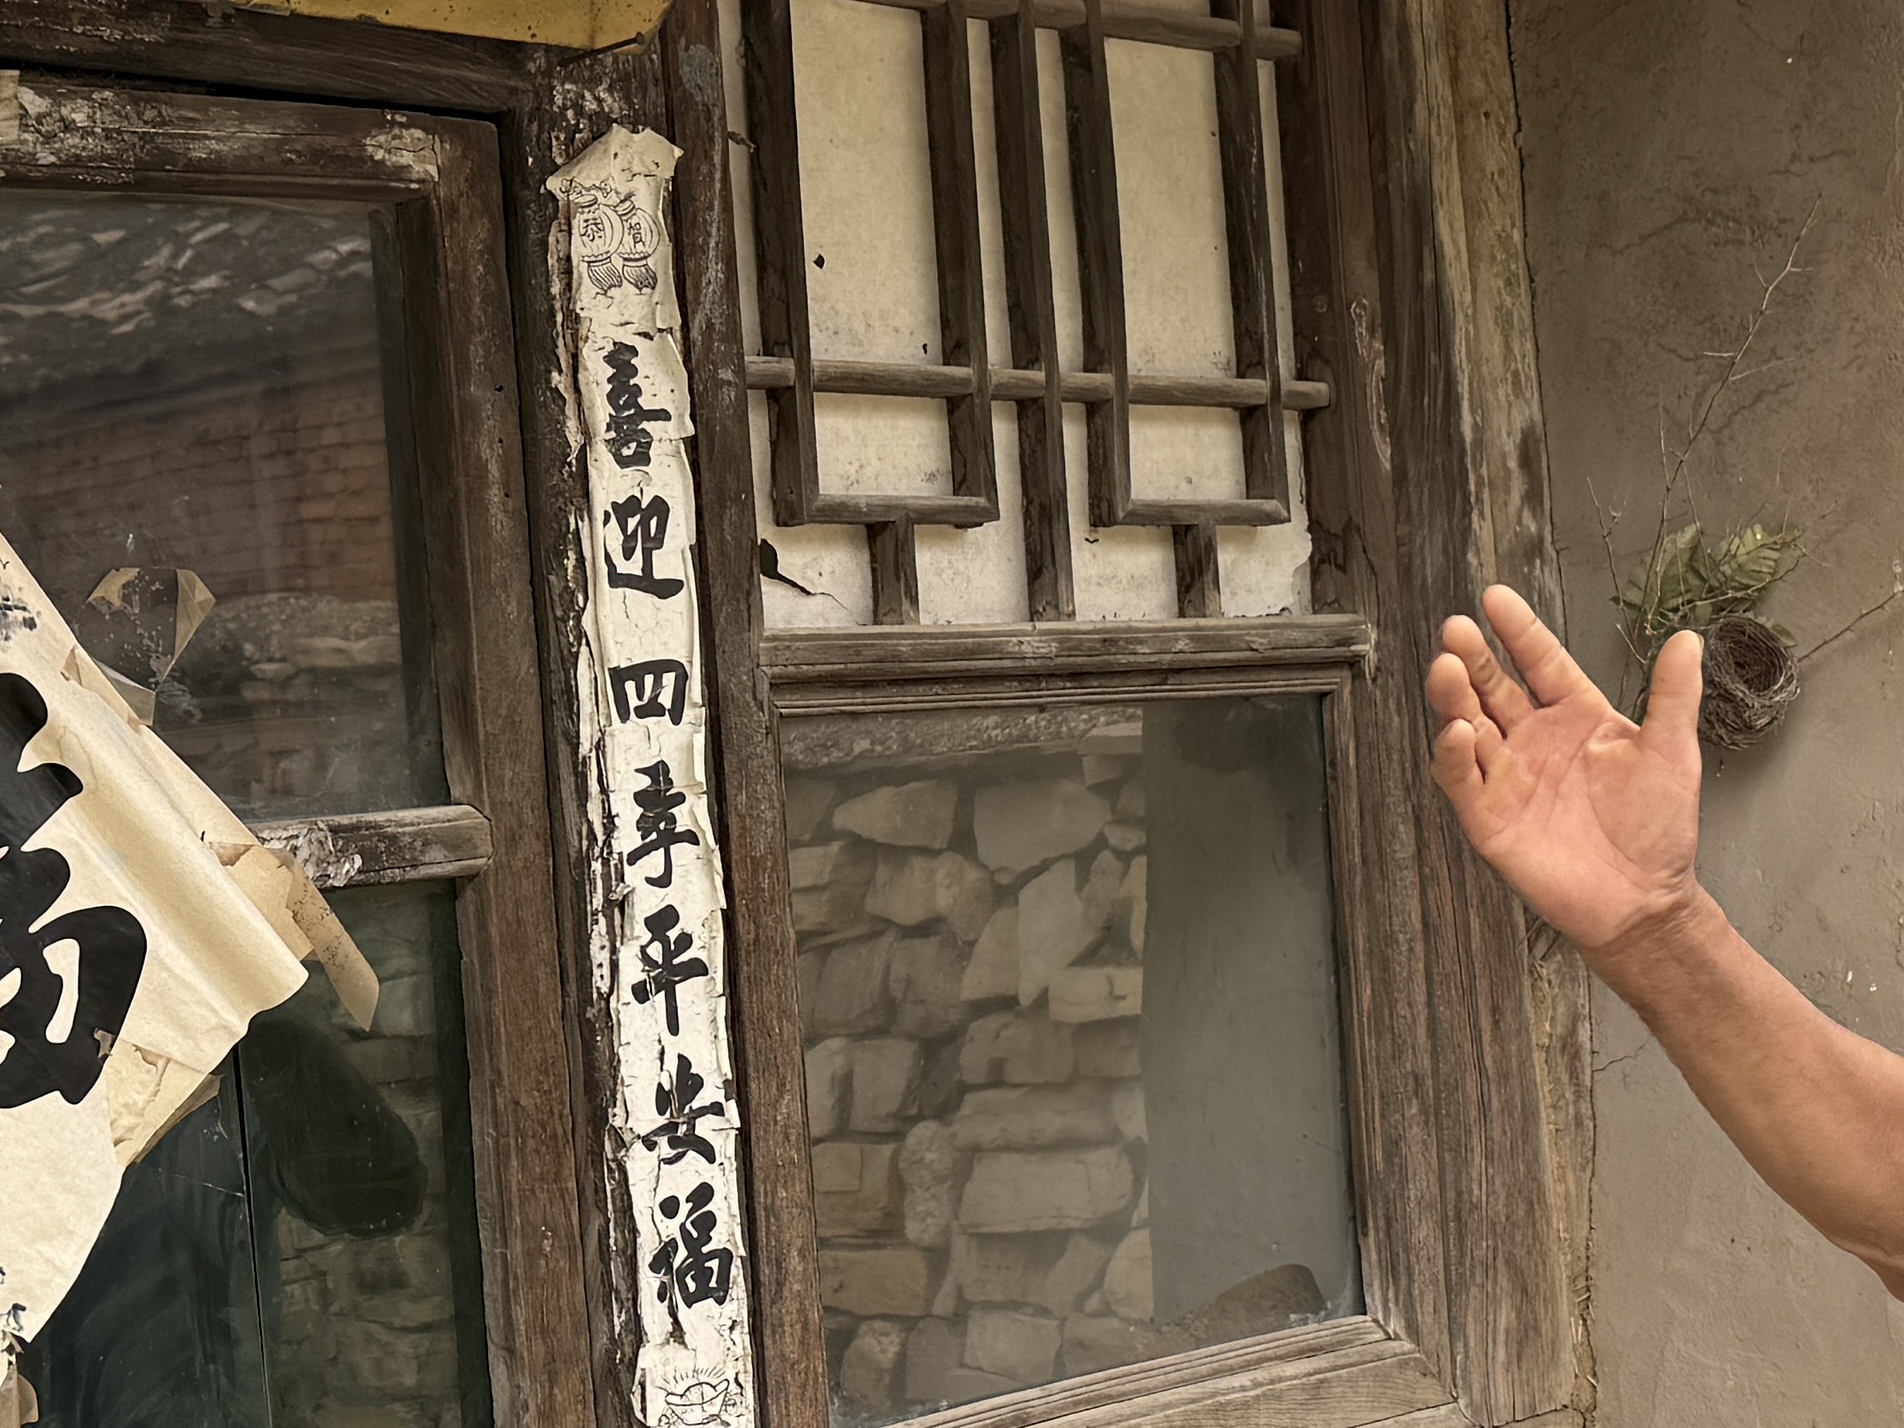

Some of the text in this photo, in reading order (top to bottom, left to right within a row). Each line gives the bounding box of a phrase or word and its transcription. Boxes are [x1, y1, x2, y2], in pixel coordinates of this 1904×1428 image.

[603, 340, 734, 1308] 喜迎四季平安福
